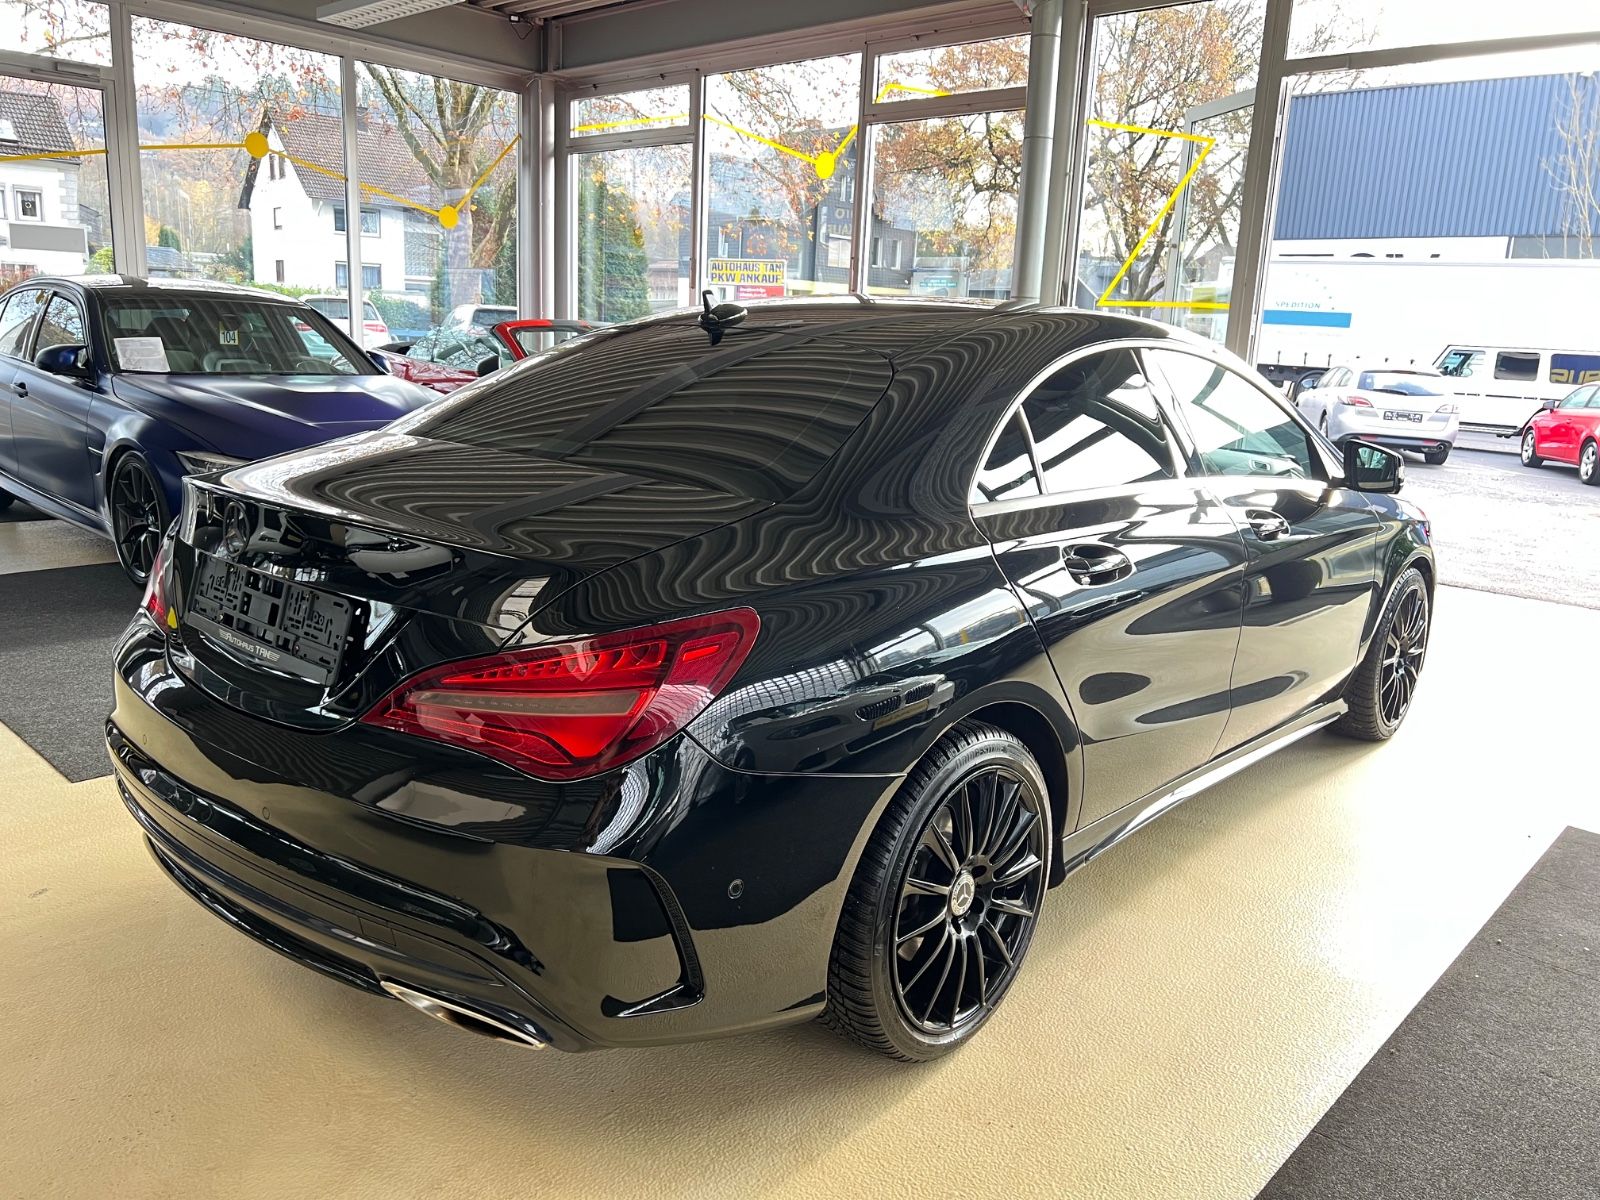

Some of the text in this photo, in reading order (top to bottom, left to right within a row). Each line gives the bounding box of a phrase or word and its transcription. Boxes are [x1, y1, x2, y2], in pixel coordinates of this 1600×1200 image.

[711, 262, 760, 272] AUTOHAUS
[710, 272, 782, 284] PKW ANKAUF
[1275, 301, 1321, 309] SPEDITION
[222, 330, 237, 344] 104
[226, 632, 255, 652] AUTOHAUS
